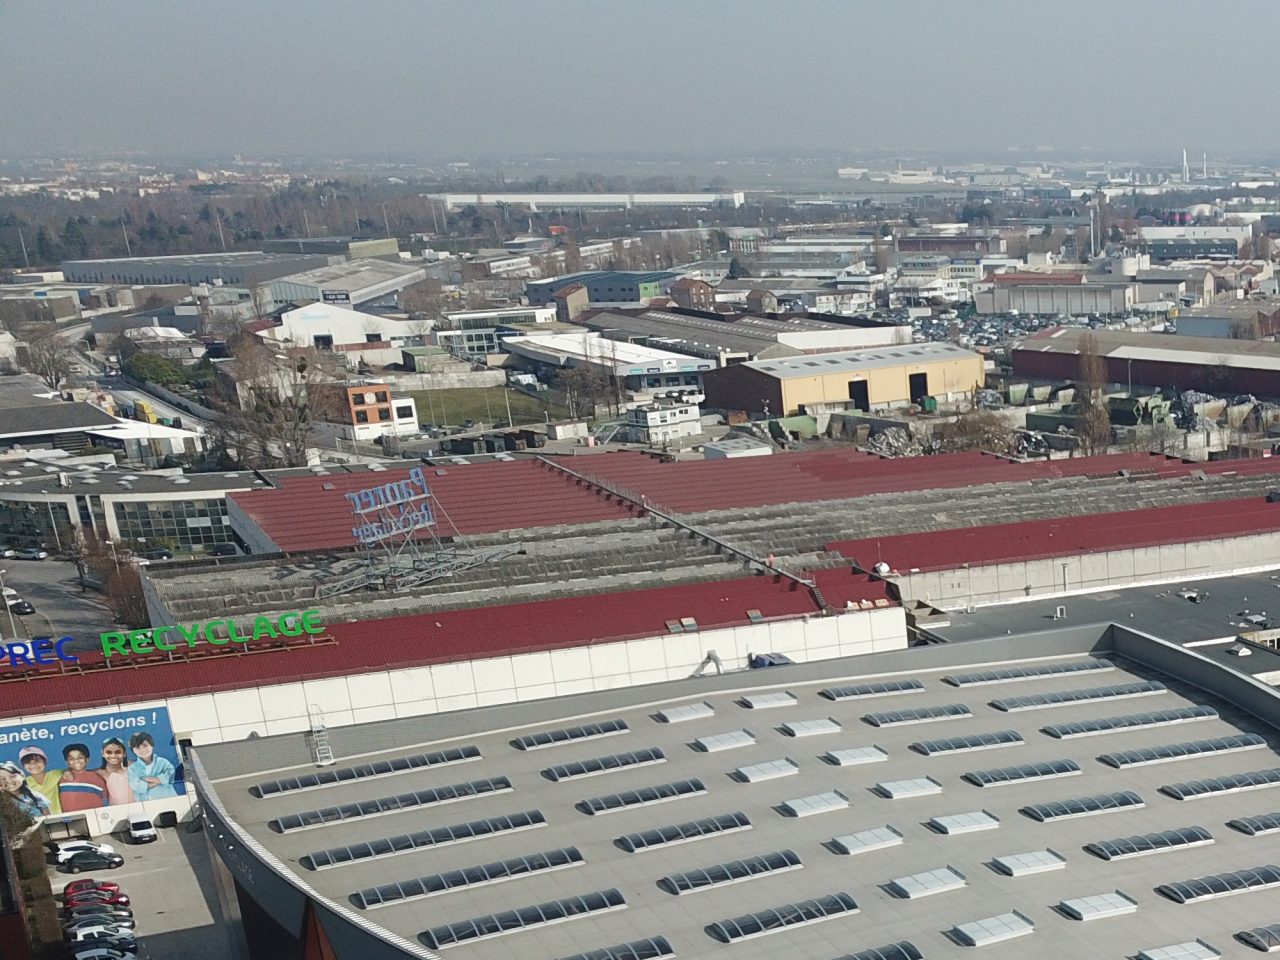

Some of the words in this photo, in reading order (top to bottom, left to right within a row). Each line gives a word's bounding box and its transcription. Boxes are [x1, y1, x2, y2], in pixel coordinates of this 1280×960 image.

[99, 609, 324, 658] RECYCLAGE
[60, 715, 146, 736] recyclons
[151, 712, 157, 724] !
